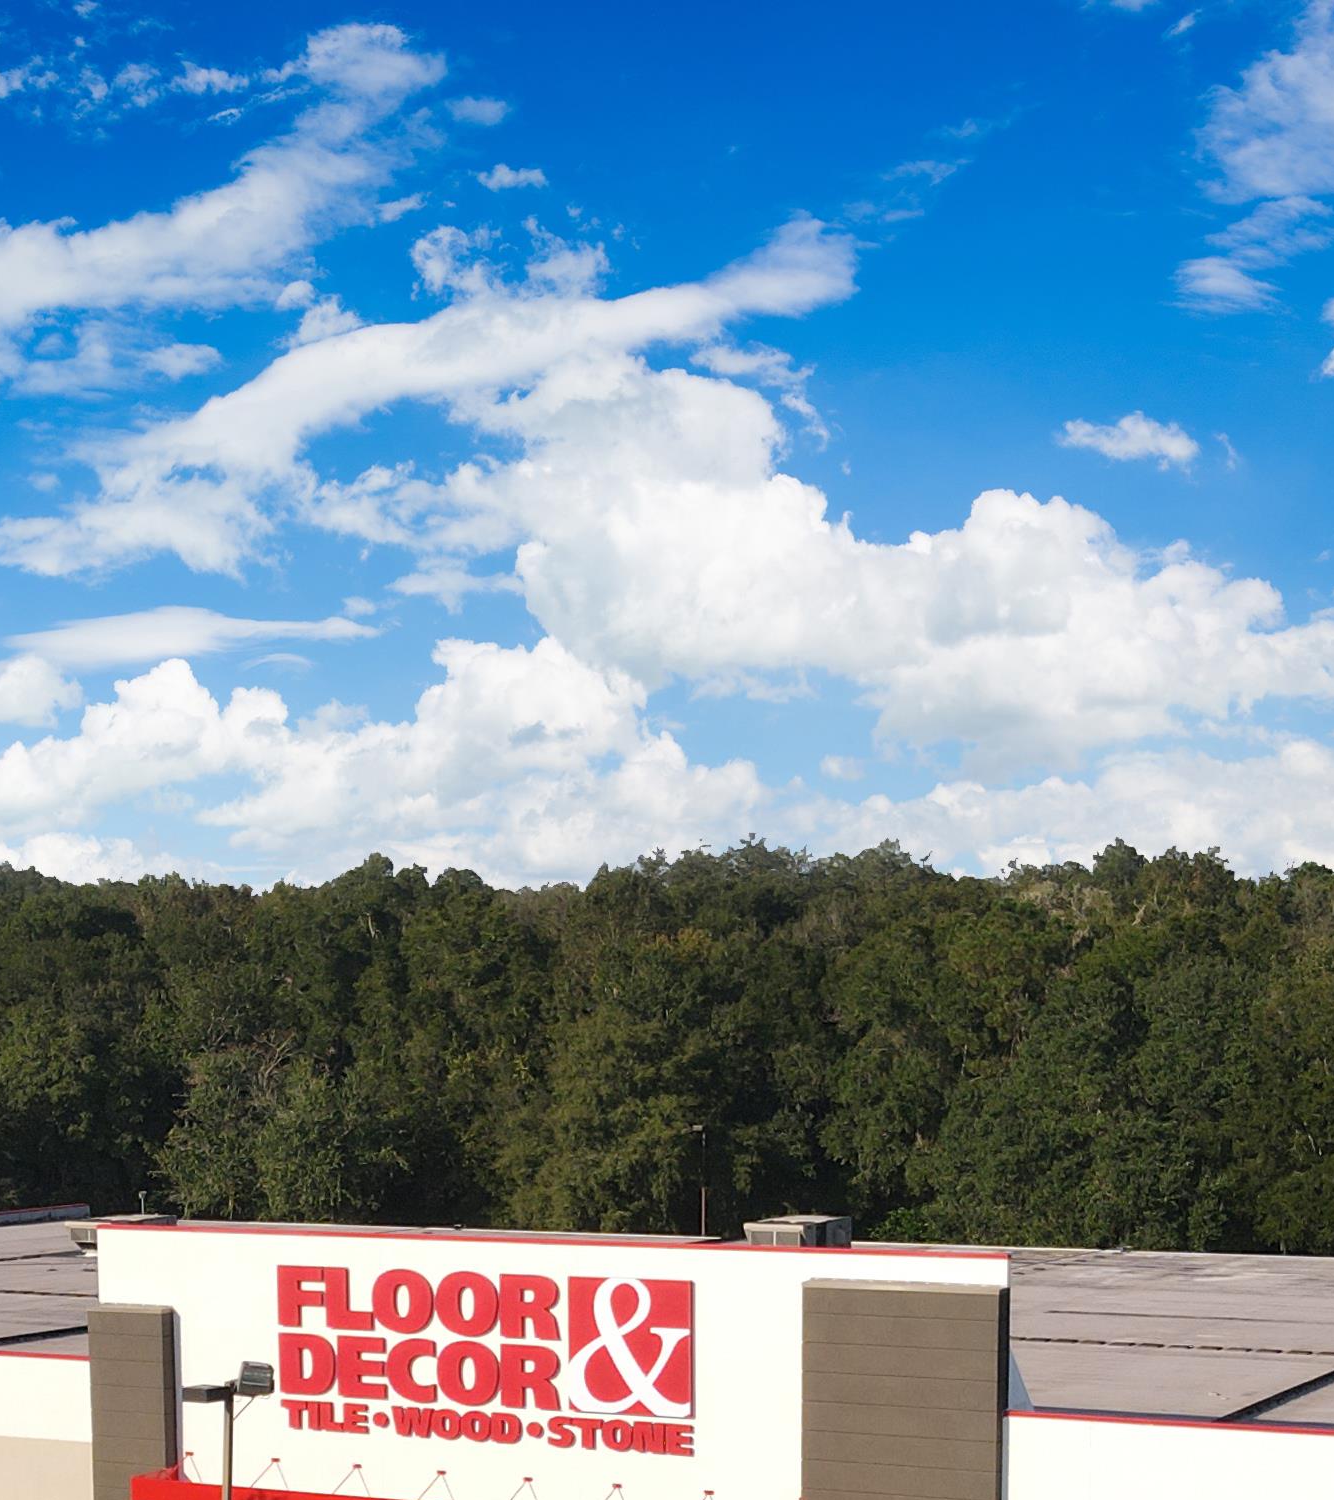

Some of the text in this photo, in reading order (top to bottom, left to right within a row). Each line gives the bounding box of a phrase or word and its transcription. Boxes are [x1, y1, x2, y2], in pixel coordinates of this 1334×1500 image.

[277, 1264, 694, 1418] FLOOR &
[278, 1332, 561, 1410] DECOR
[280, 1399, 694, 1456] TILE WOOD STONE
